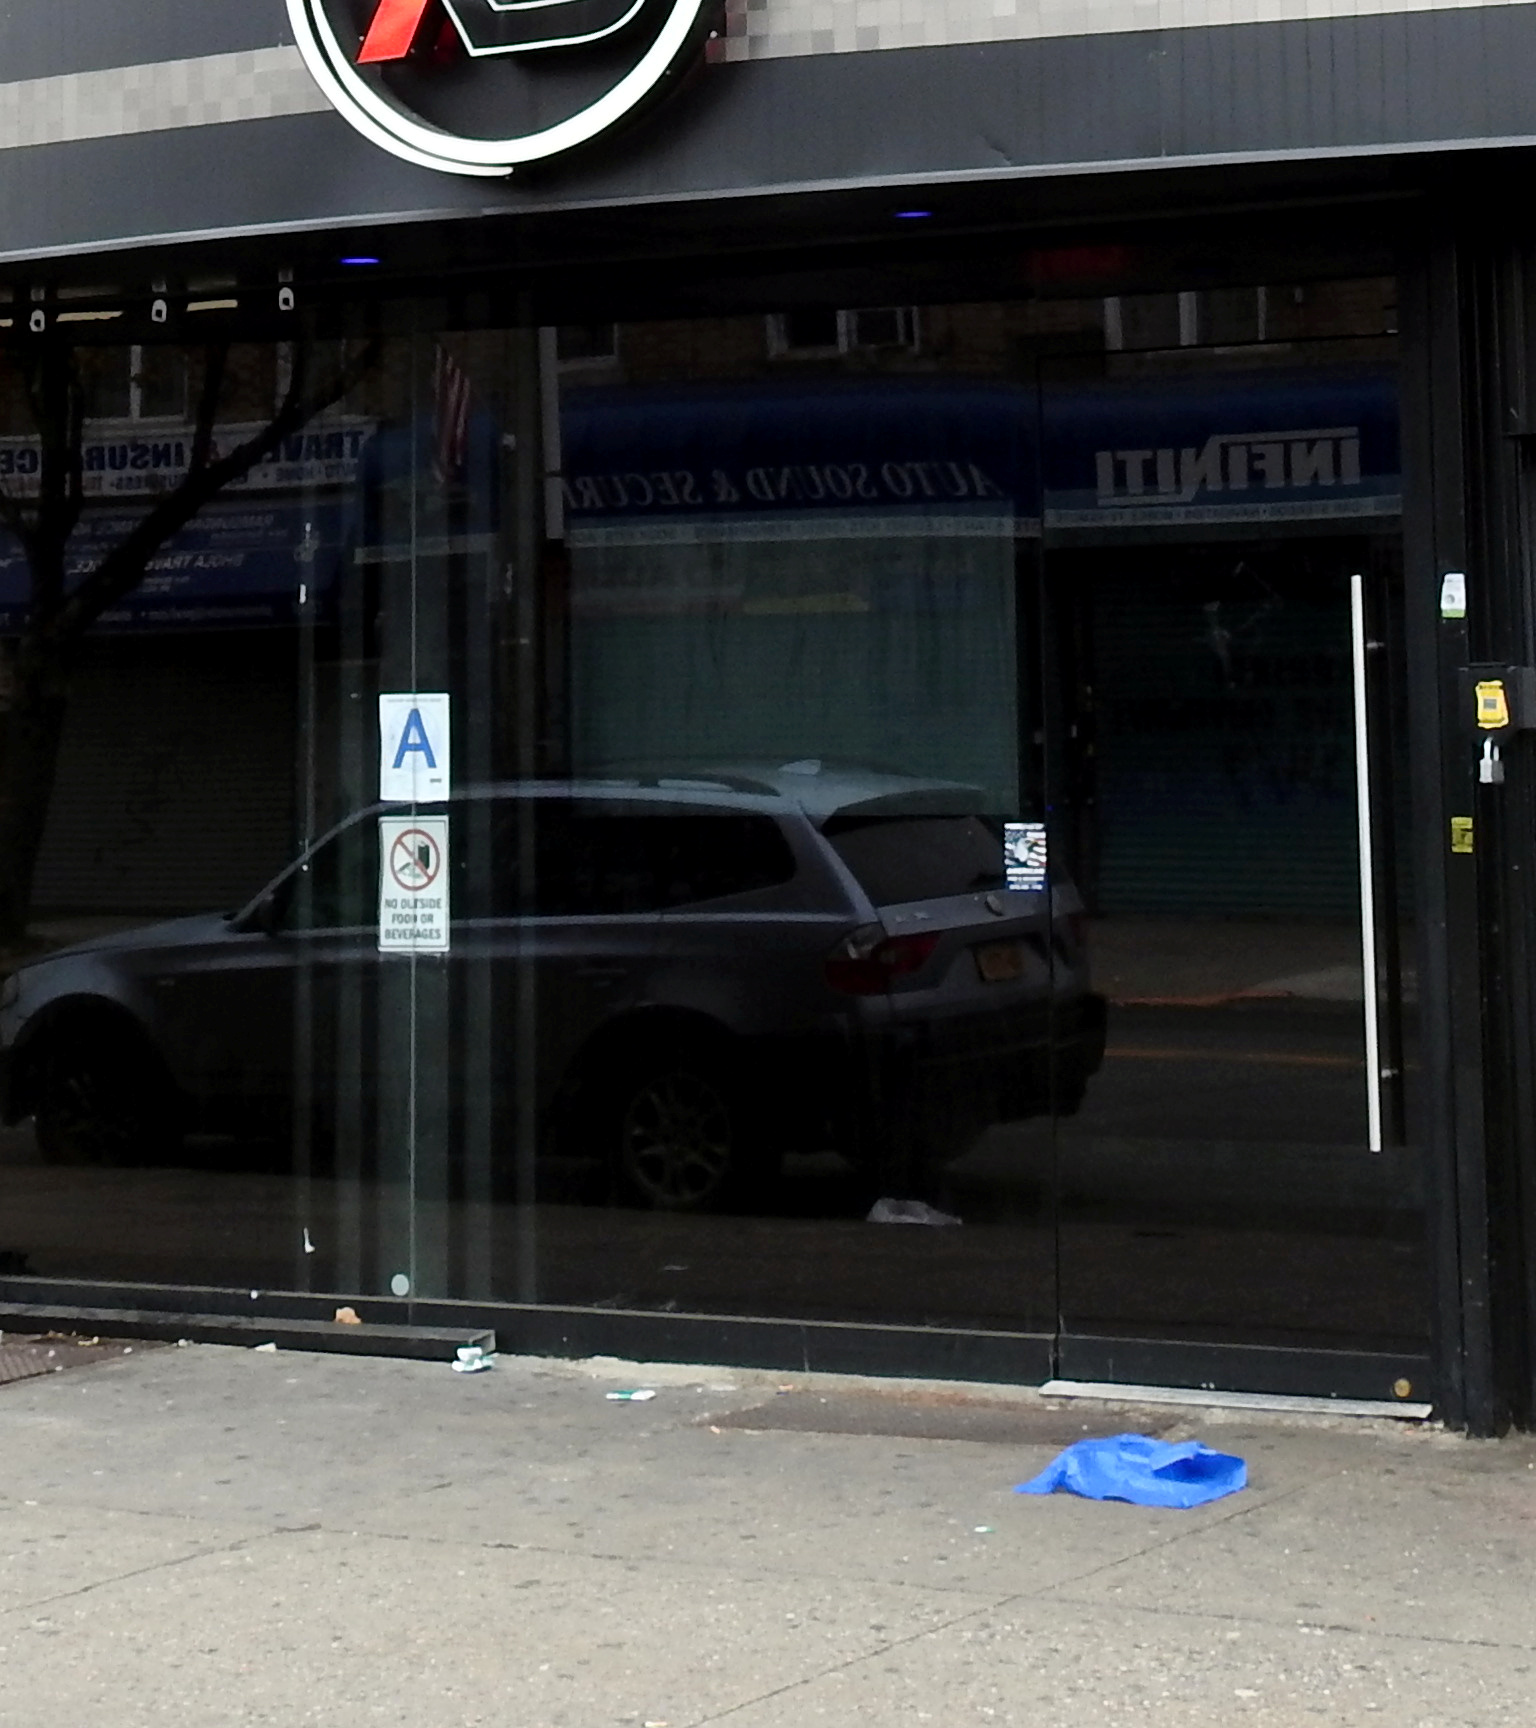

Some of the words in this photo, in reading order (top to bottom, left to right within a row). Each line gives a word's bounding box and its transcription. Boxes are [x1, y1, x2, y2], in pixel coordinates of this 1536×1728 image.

[392, 708, 436, 768] A
[420, 913, 434, 924] OR
[385, 928, 441, 940] BEVERAGES
